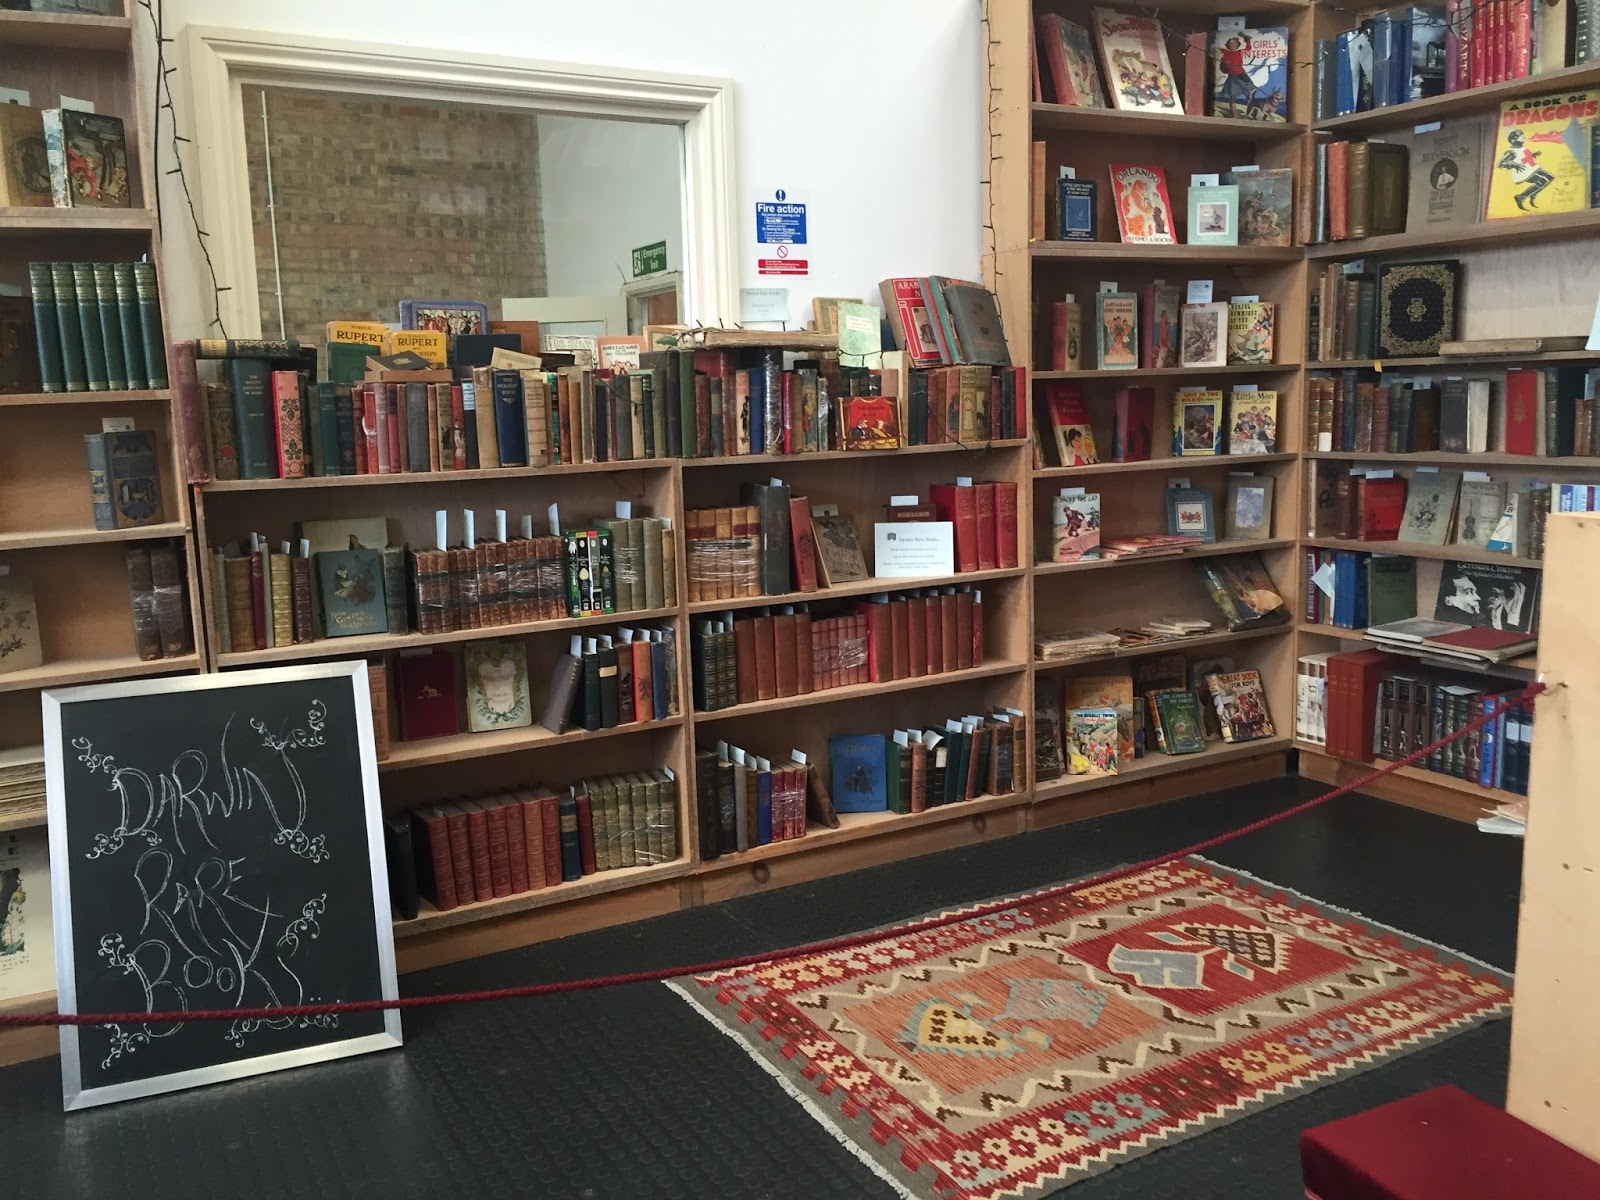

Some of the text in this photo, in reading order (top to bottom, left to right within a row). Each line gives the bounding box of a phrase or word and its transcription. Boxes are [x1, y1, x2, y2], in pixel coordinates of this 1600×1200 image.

[1242, 49, 1287, 59] INTERESTS
[1524, 97, 1562, 108] BOOK
[1568, 94, 1587, 103] OF
[1503, 100, 1599, 126] DRAGONS
[1117, 167, 1160, 184] ORLANDO
[757, 203, 804, 214] Fire action
[898, 281, 919, 290] ARAB
[336, 330, 385, 343] RUPERT
[398, 337, 439, 347] RUPERT
[1235, 391, 1274, 401] Little Men
[1242, 671, 1258, 681] BOOK
[112, 712, 306, 855] DARWIN
[134, 847, 284, 958] RARE
[127, 898, 304, 1038] BOOKS
